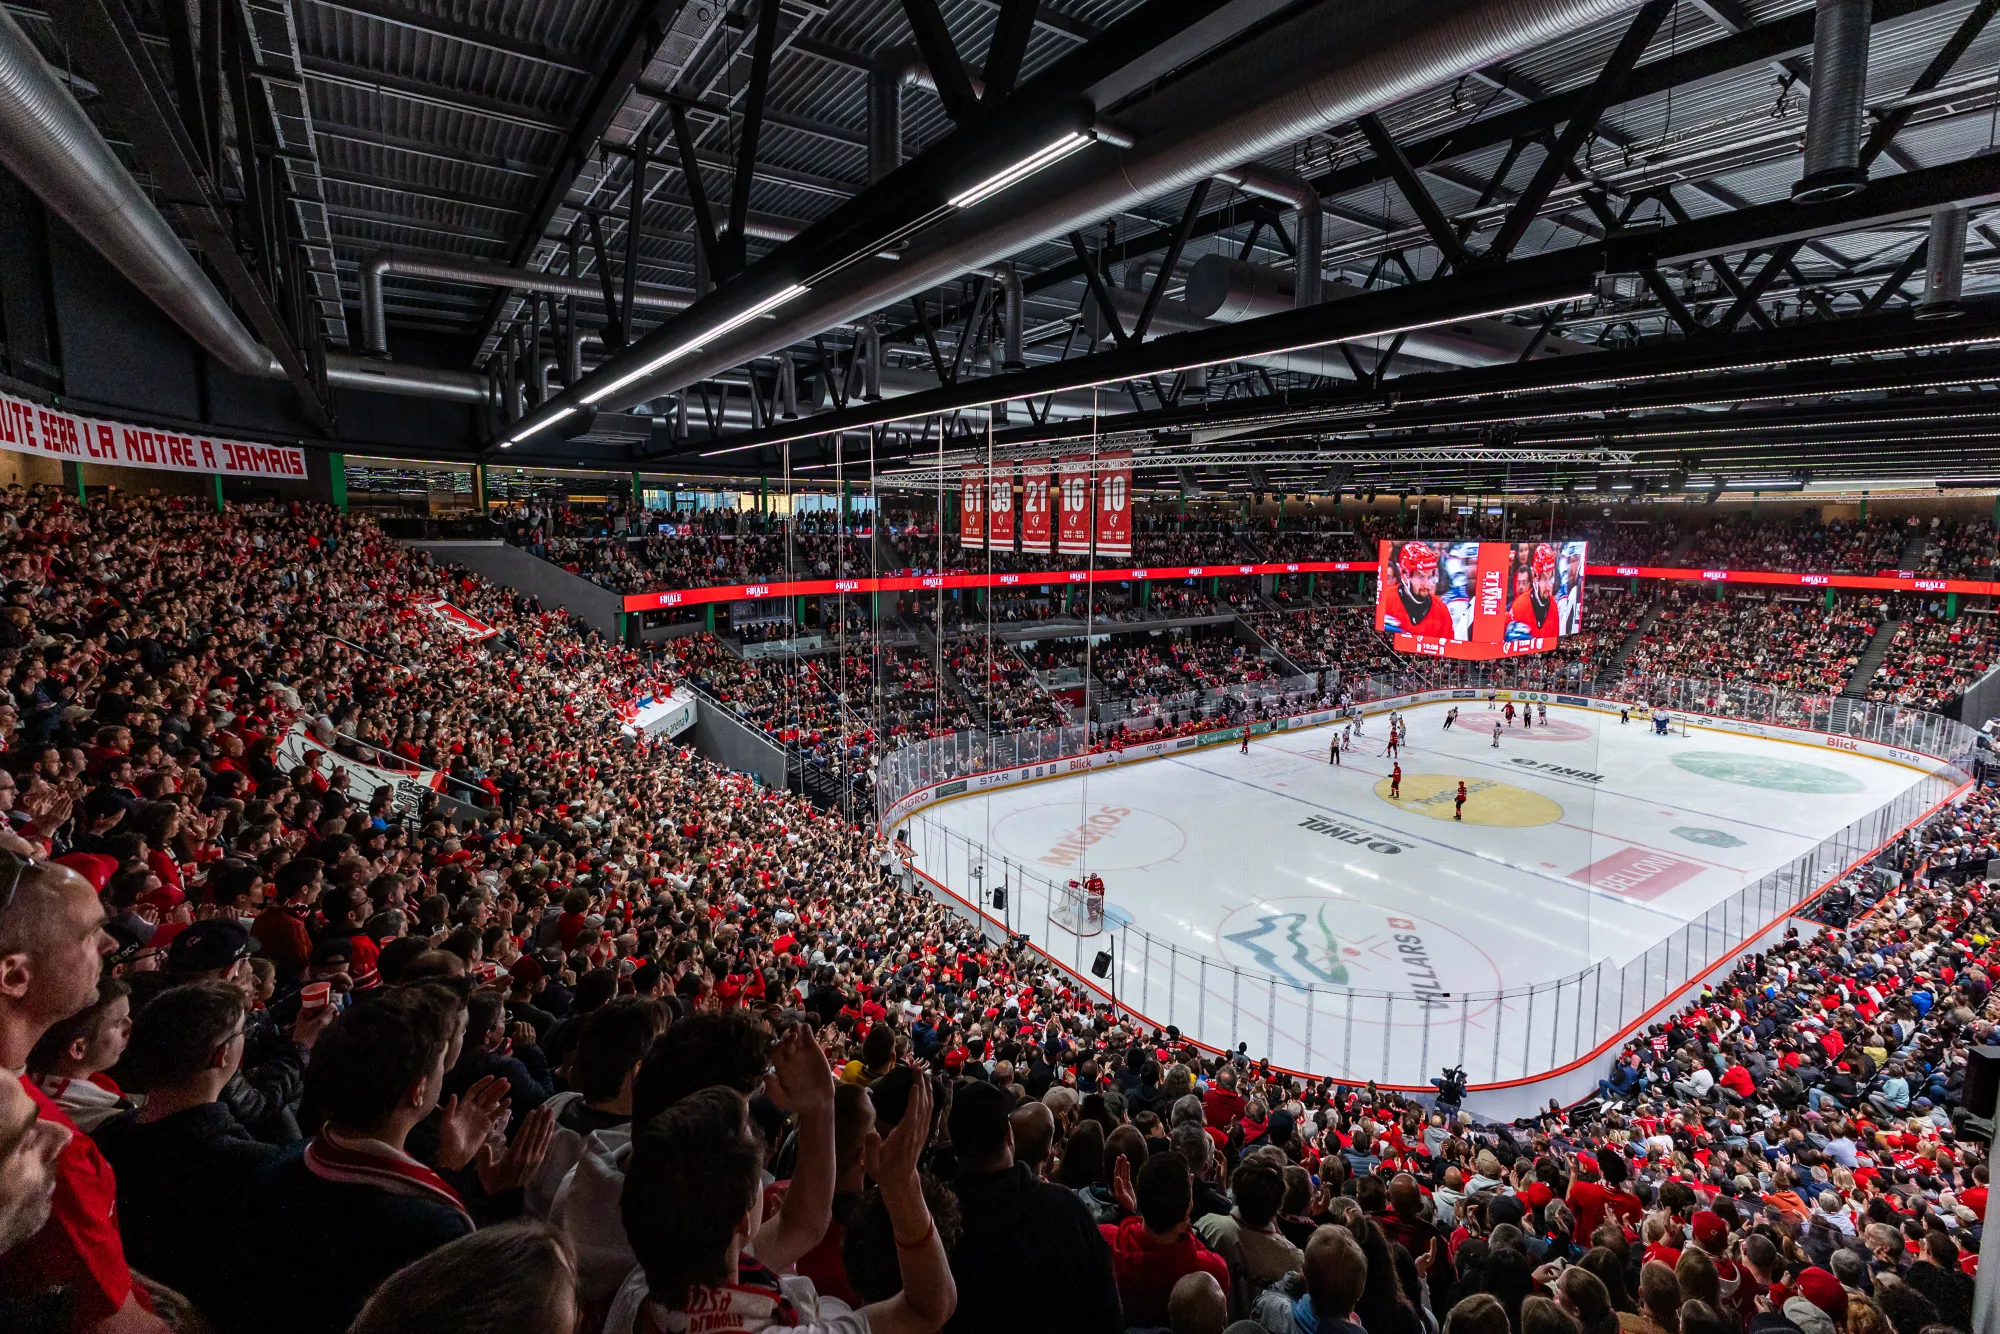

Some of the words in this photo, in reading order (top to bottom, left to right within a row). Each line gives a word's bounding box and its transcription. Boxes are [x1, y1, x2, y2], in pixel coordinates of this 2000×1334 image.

[0, 397, 37, 449] UTE
[39, 410, 80, 456] SERA
[83, 422, 118, 460] LA
[123, 428, 198, 468] NOTRE
[200, 441, 217, 469] A
[222, 443, 304, 475] JAMAIS
[964, 483, 981, 513] 61
[991, 481, 1011, 513] 39
[1025, 480, 1046, 512] 21
[1061, 477, 1085, 512] 16
[1101, 475, 1126, 512] 10
[660, 593, 681, 604] FINALE
[746, 586, 768, 595] FINALE
[1482, 571, 1500, 616] FINALE
[1914, 582, 1946, 590] FINALE
[1826, 736, 1858, 751] Blick
[1888, 749, 1920, 763] STAR
[1069, 757, 1092, 771] Blick
[1536, 763, 1606, 780] FINAL
[980, 772, 1009, 786] STAR
[1037, 805, 1131, 867] MIGROS
[1297, 817, 1374, 845] FINAL
[1393, 934, 1450, 1011] VILLARS
